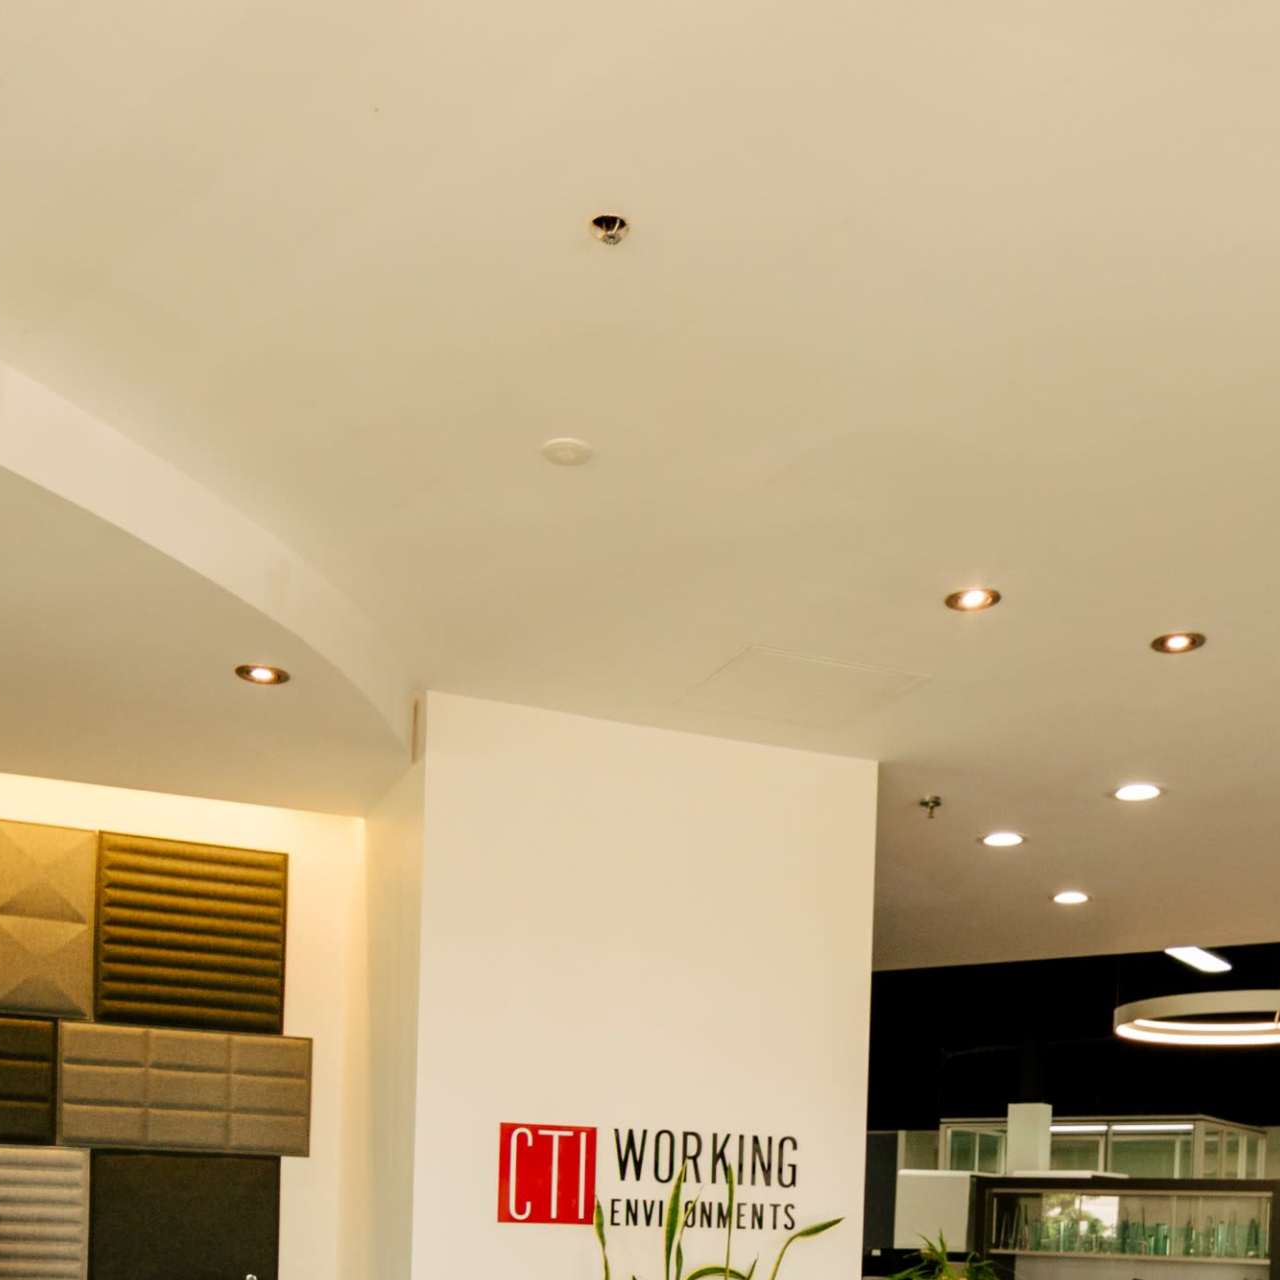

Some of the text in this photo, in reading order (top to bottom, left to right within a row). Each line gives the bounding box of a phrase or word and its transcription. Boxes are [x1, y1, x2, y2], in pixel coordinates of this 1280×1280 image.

[508, 1127, 588, 1221] CTI
[613, 1128, 798, 1188] WORKING
[610, 1198, 797, 1231] ENVIONMENTS
